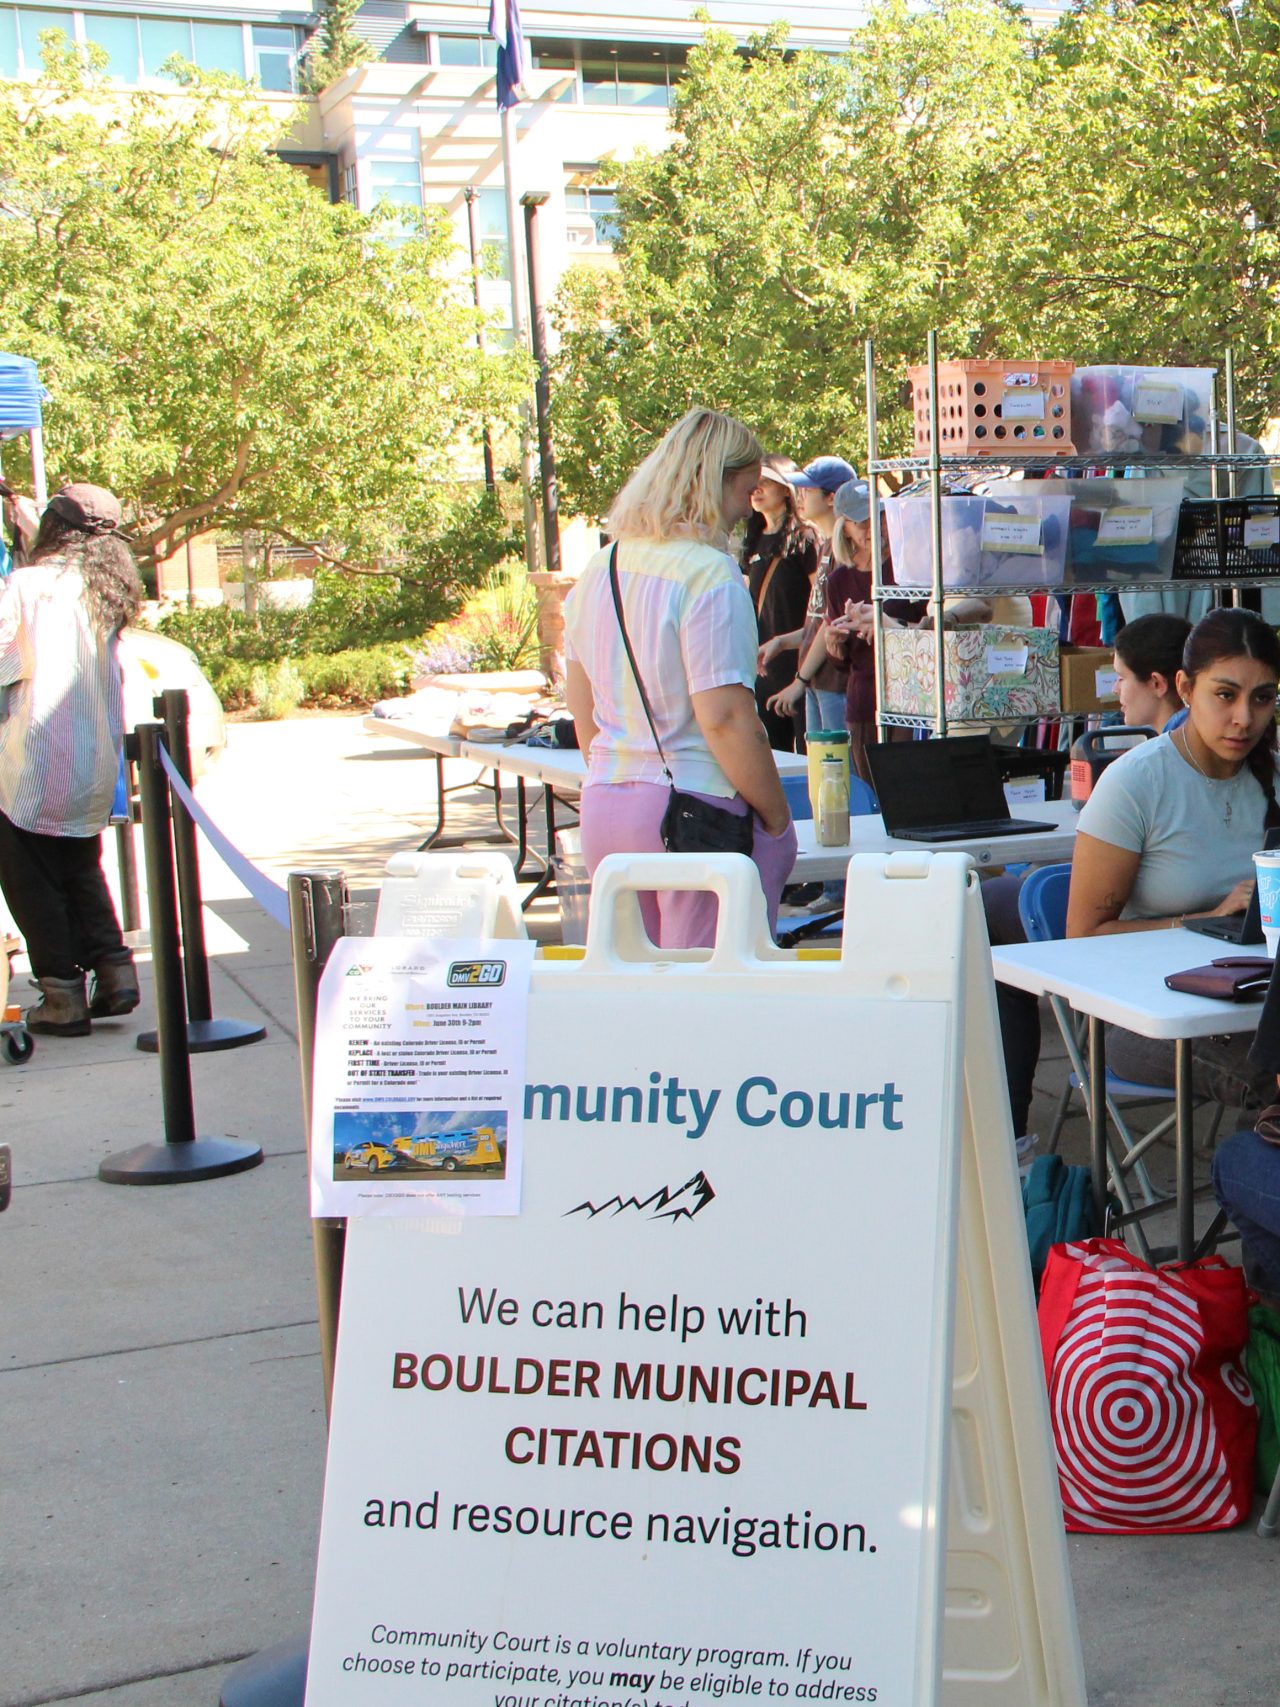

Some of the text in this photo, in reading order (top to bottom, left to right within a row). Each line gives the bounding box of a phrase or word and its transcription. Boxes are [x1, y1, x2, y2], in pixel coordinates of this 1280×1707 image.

[426, 1002, 452, 1010] BOULDER
[452, 1002, 468, 1010] MAIN
[523, 1072, 904, 1139] munity Court
[458, 1286, 807, 1344] We can help with
[392, 1352, 868, 1411] BOULDER MUNICIPAL
[504, 1426, 742, 1475] CITATIONS
[363, 1490, 877, 1558] and resource navigation.
[371, 1624, 852, 1675] Community Court is a voluntary program. If you
[342, 1652, 878, 1703] choose to participate, you may be eligible to address
